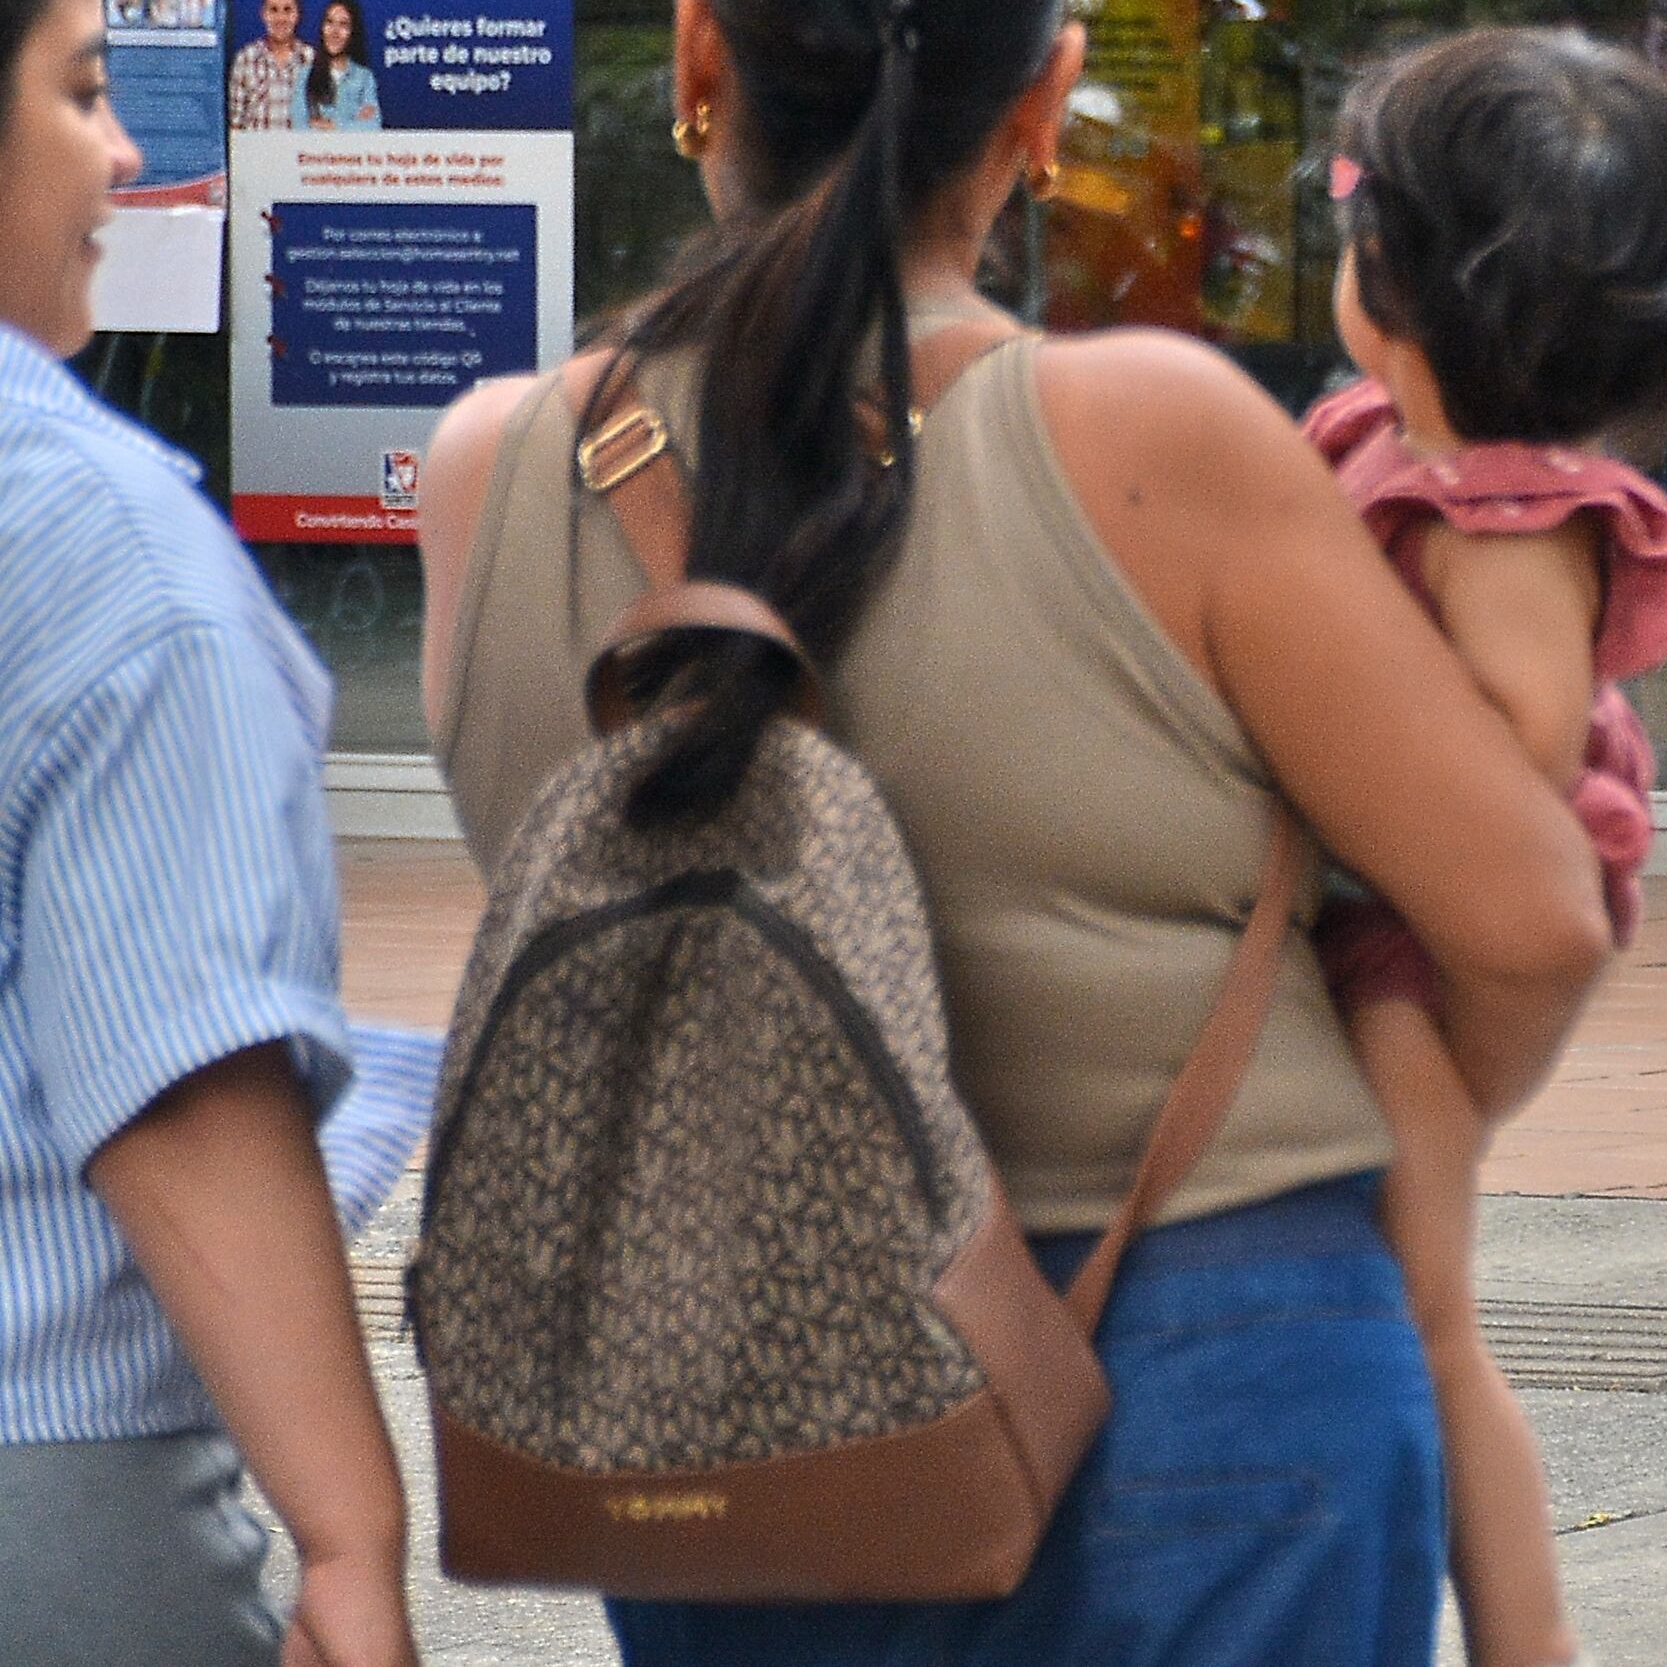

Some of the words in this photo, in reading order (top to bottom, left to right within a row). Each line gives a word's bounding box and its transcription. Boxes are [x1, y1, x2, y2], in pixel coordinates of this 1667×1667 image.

[384, 14, 473, 41] ¿Quieres
[475, 15, 547, 38] formar
[383, 45, 439, 68] parte
[442, 44, 470, 65] de
[472, 45, 552, 66] nuestro
[429, 68, 512, 95] equipo?
